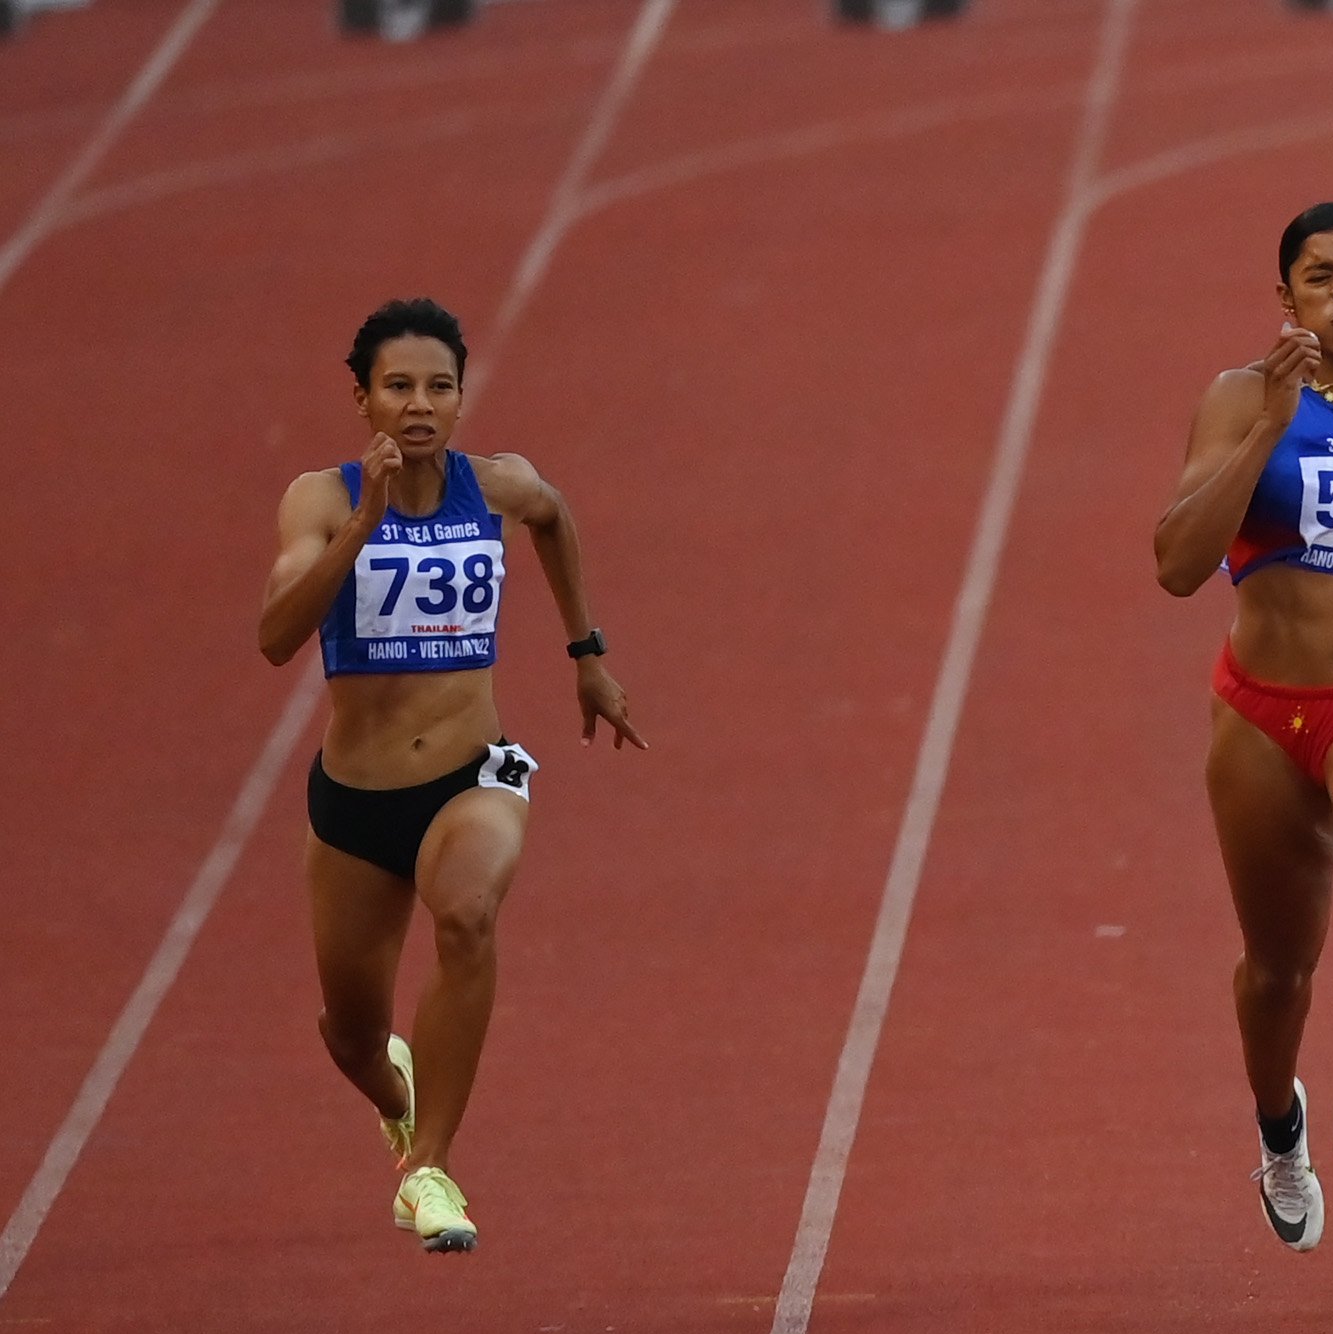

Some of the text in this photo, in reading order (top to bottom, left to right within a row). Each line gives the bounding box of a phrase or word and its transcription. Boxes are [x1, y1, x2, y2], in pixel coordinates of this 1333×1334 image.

[405, 525, 432, 544] SEA
[434, 521, 480, 540] Games
[370, 553, 493, 616] 738
[368, 641, 408, 660] HANOI
[419, 638, 473, 659] VIETNAM
